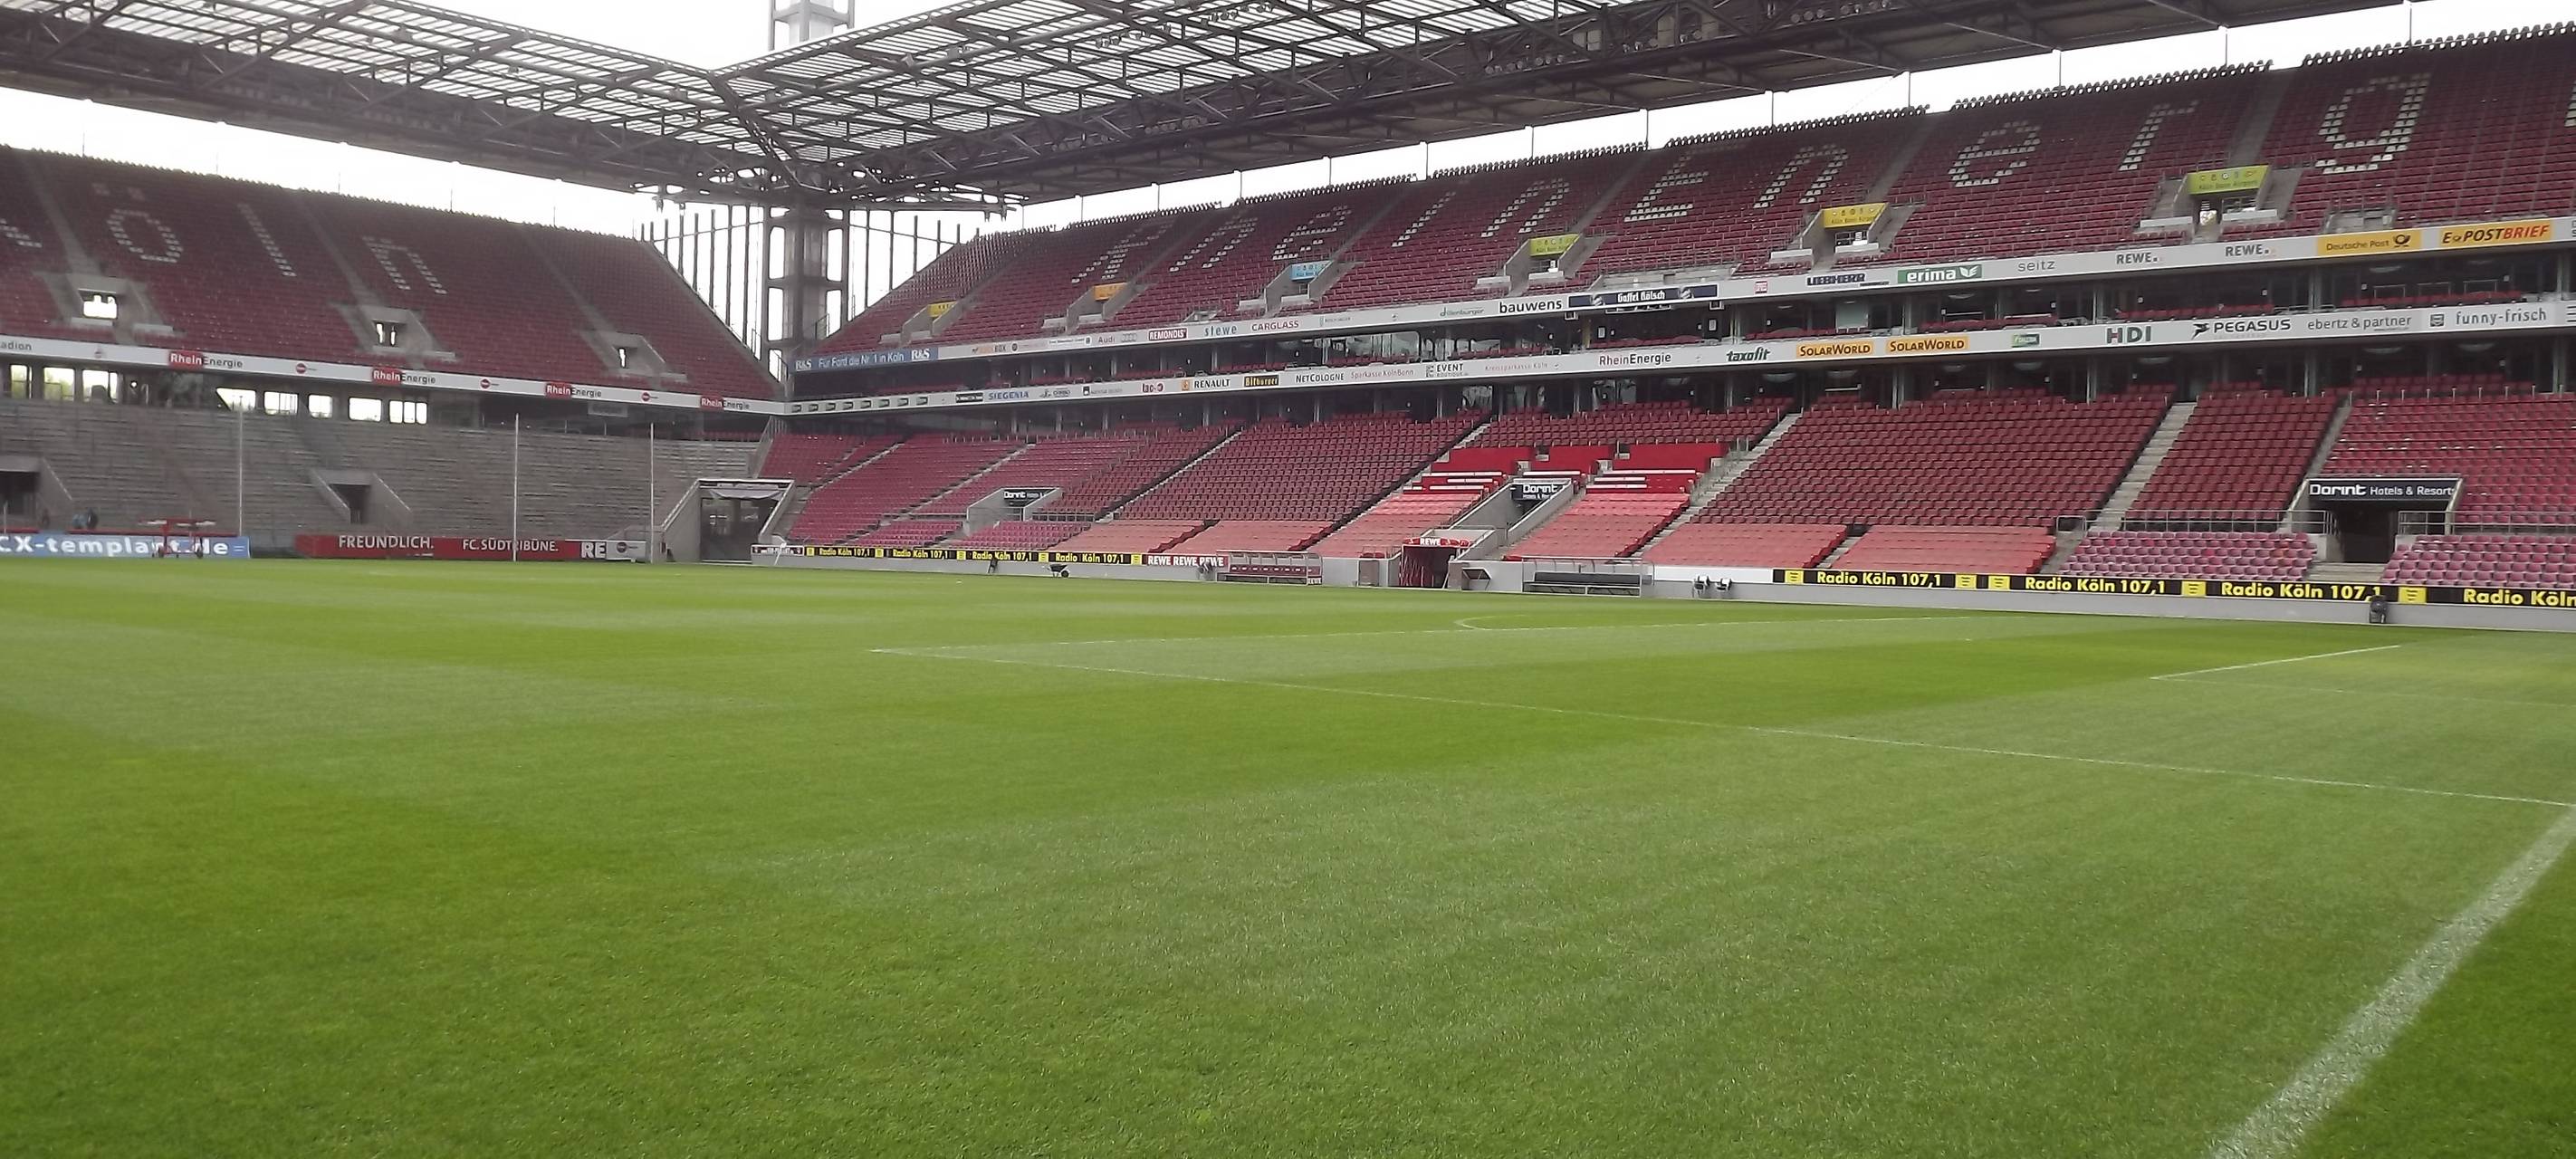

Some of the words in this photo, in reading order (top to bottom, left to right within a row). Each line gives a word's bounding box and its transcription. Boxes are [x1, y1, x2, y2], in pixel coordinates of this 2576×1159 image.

[0, 183, 448, 295] öln
[2326, 240, 2368, 252] Deutsche
[2370, 238, 2389, 249] Post
[2017, 259, 2055, 273] seitz
[1907, 268, 1956, 283] erima
[1499, 299, 1562, 314] bauwens
[2307, 318, 2349, 330] ebertz
[2351, 317, 2361, 329] &
[2363, 317, 2412, 330] partner
[2456, 308, 2547, 326] funny-frisch
[1204, 324, 1238, 337] stewe
[1251, 321, 1299, 331] CARGLASS
[2213, 319, 2292, 334] PEGASUS
[1097, 336, 1116, 344] Audi
[2106, 325, 2152, 345] HDI
[911, 348, 931, 361] R&S
[1726, 346, 1771, 362] taxofit
[795, 359, 812, 372] R&S
[1436, 363, 1464, 373] EVENT
[1193, 378, 1231, 389] RENAULT
[988, 390, 1029, 400] SIEGENIA
[2309, 484, 2367, 495] Dorint
[2370, 486, 2403, 496] Hotels
[2405, 486, 2414, 495] &
[339, 535, 435, 549] FREUNDLICH.
[1419, 537, 1441, 546] REWE
[819, 547, 837, 556] Radio
[838, 547, 852, 557] Köln
[893, 549, 912, 558] Radio
[913, 548, 929, 559] Köln
[972, 551, 992, 560] Radio
[995, 551, 1010, 560] Köln
[1056, 553, 1077, 562] Radio
[1082, 553, 1100, 563] Köln
[1148, 555, 1172, 566] REWE
[1173, 556, 1197, 567] REWE
[1816, 570, 1858, 584] Radio
[1862, 570, 1896, 586] Köln
[2025, 577, 2072, 591] Radio
[2077, 578, 2116, 593] Köln
[2221, 582, 2274, 598] Radio
[2279, 583, 2323, 599] Köln
[2464, 589, 2523, 605] Radio
